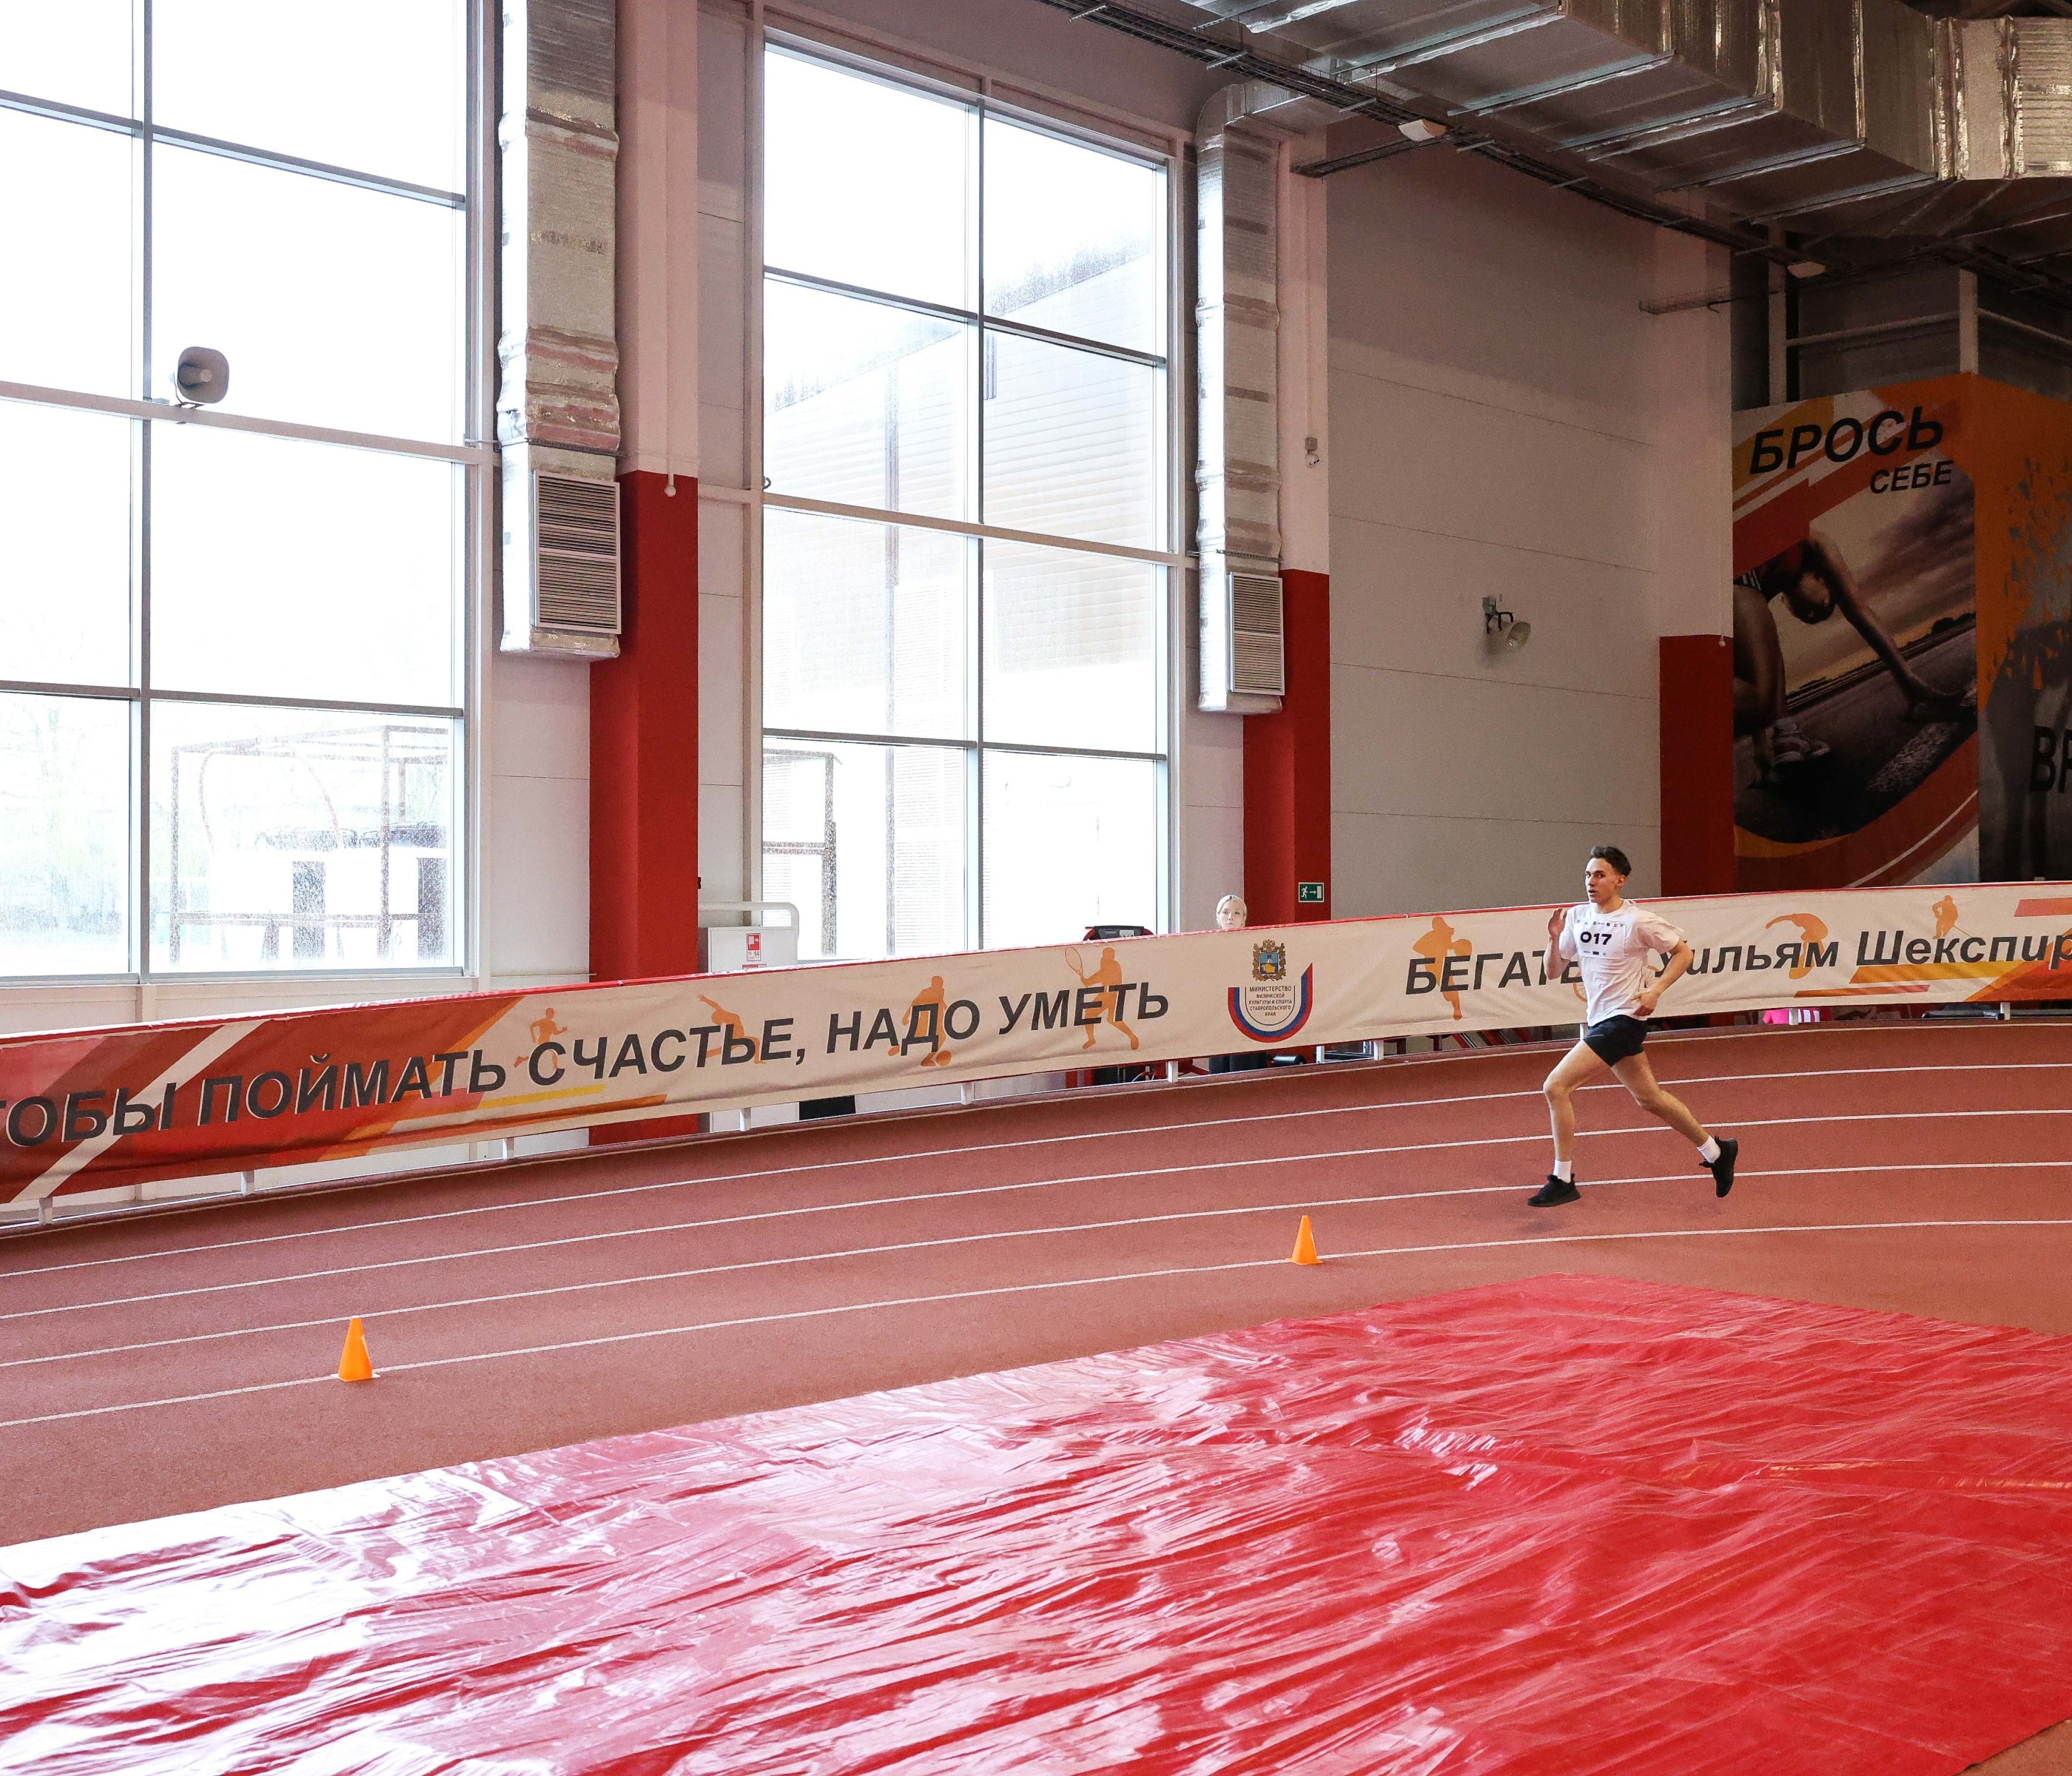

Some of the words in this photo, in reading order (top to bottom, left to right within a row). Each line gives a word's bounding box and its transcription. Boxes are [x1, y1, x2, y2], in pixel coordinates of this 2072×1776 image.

[1749, 406, 1944, 475] БРОСЬ
[1870, 460, 1954, 494] СЕБЕ
[1580, 931, 1612, 946] 017
[1855, 929, 2072, 971] Шекспир
[0, 1082, 178, 1148] ОБЫ
[197, 1049, 507, 1127] ПОЙМАТЬ
[528, 1017, 806, 1086] СЧАСТЬЕ,
[826, 999, 980, 1057] НАДО
[998, 981, 1170, 1035] УМЕТЬ
